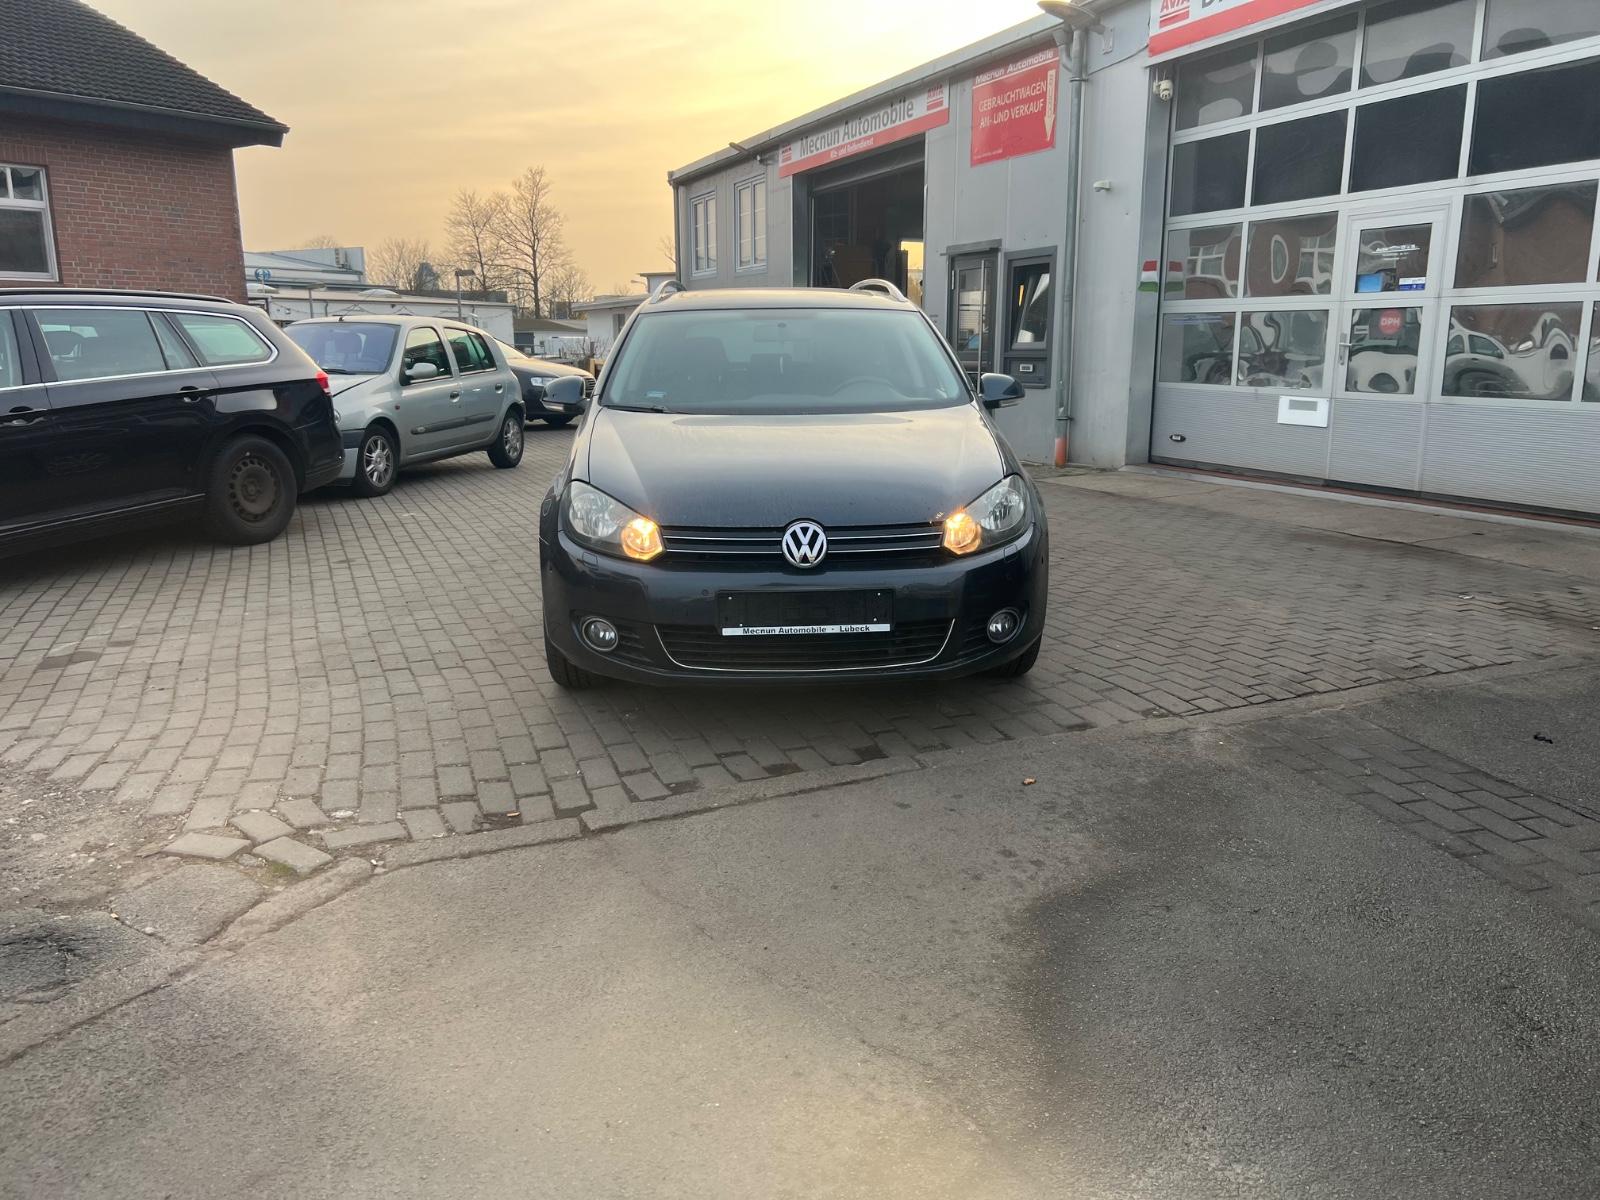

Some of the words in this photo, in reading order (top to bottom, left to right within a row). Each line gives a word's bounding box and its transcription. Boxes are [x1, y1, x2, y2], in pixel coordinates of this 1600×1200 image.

[1007, 50, 1054, 74] Automobile
[978, 80, 1047, 113] GEBRAUCHTWAGEN
[800, 130, 840, 158] Mecnun
[842, 97, 915, 141] Automobile
[979, 116, 993, 129] AN-
[993, 110, 1010, 124] UND
[1011, 98, 1045, 119] VERKAUF
[742, 627, 776, 635] Mecnun
[778, 626, 827, 634] Automobile
